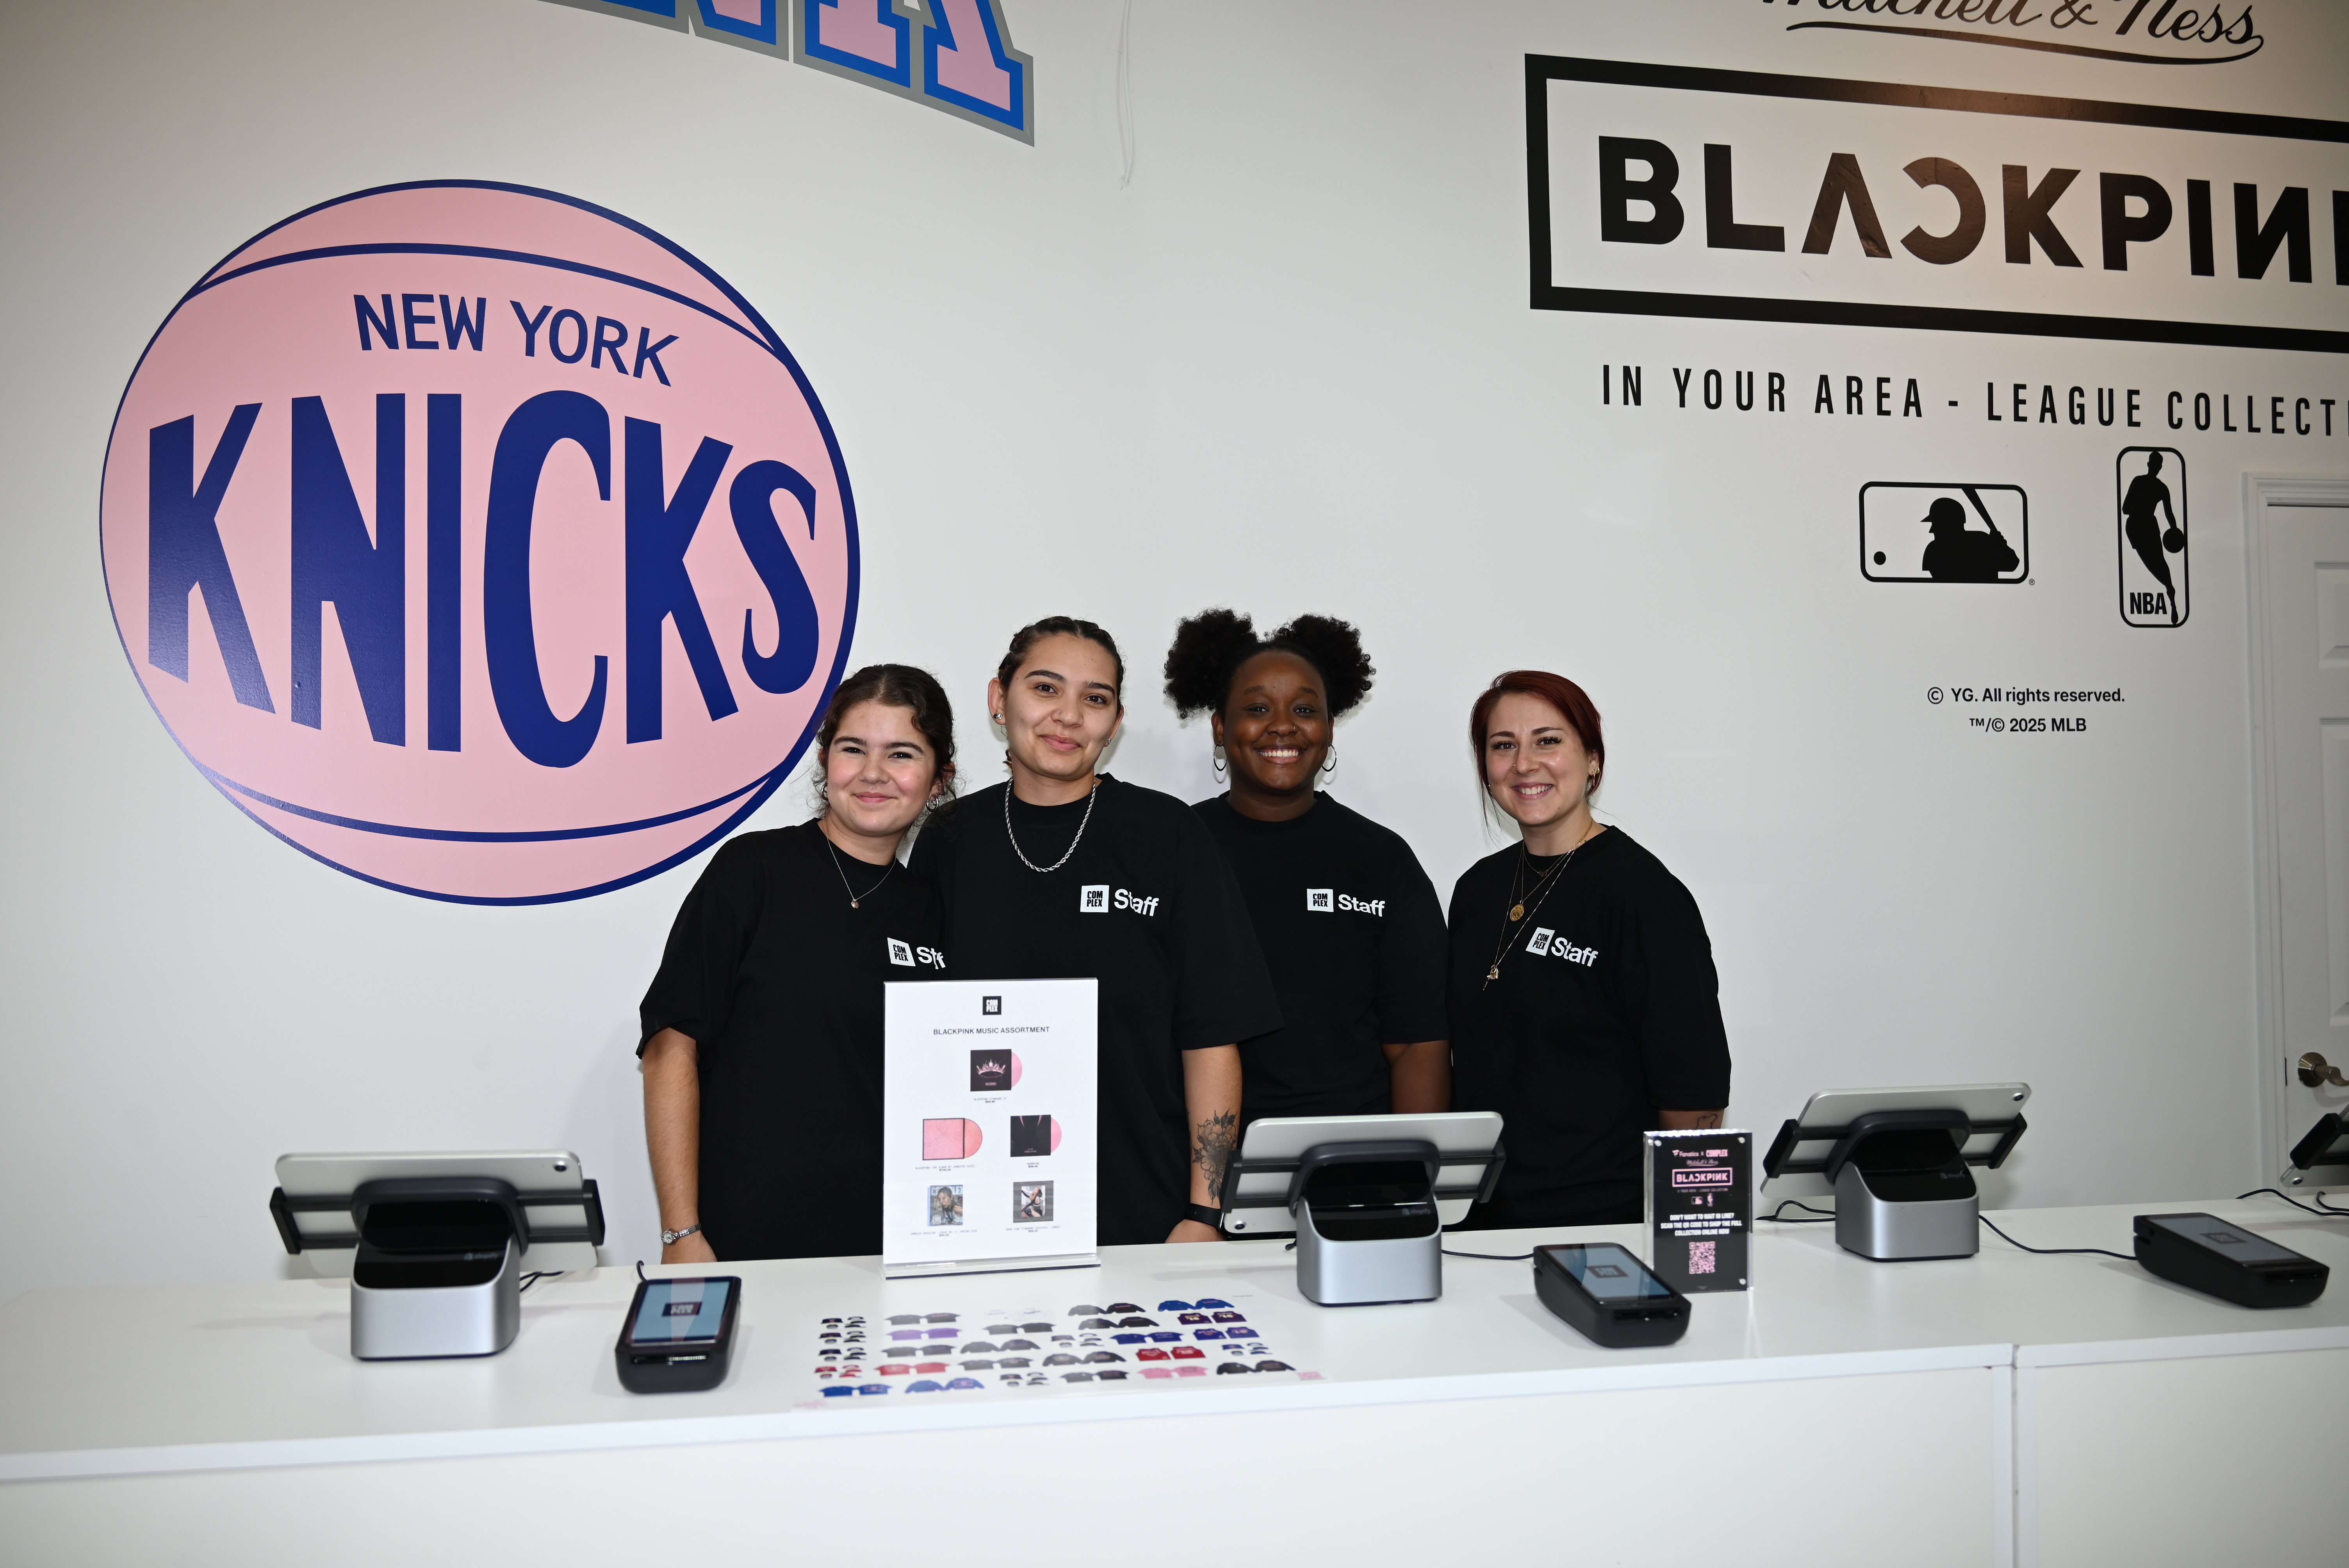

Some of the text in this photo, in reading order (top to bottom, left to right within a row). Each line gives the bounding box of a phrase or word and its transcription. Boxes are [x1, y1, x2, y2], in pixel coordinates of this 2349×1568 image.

[2050, 0, 2098, 29] &
[2114, 0, 2263, 44] Ness
[354, 294, 679, 387] NEW YORK
[1604, 365, 1641, 406] IN
[1673, 368, 1784, 412] YOUR
[1815, 375, 1922, 417] AREA
[1988, 382, 2140, 427] LEAGUE
[2168, 391, 2349, 437] COLLECT
[149, 390, 819, 768] KNICKS
[2130, 592, 2167, 615] NBA
[1951, 688, 1978, 702] YG.
[1982, 688, 2001, 701] All
[2006, 687, 2050, 705] rights
[2055, 688, 2124, 702] reserved.
[2010, 718, 2046, 732] 2025
[2052, 718, 2086, 731] MLB
[1087, 891, 1103, 899] COM
[1114, 889, 1159, 916] Staff
[1338, 894, 1385, 917] Staff
[1533, 940, 1546, 950] PLEX
[1536, 933, 1549, 943] COM
[893, 944, 906, 954] COM
[894, 952, 908, 961] PLEX
[1551, 937, 1599, 967] Staff
[1676, 1173, 1728, 1182] BLACKPINK
